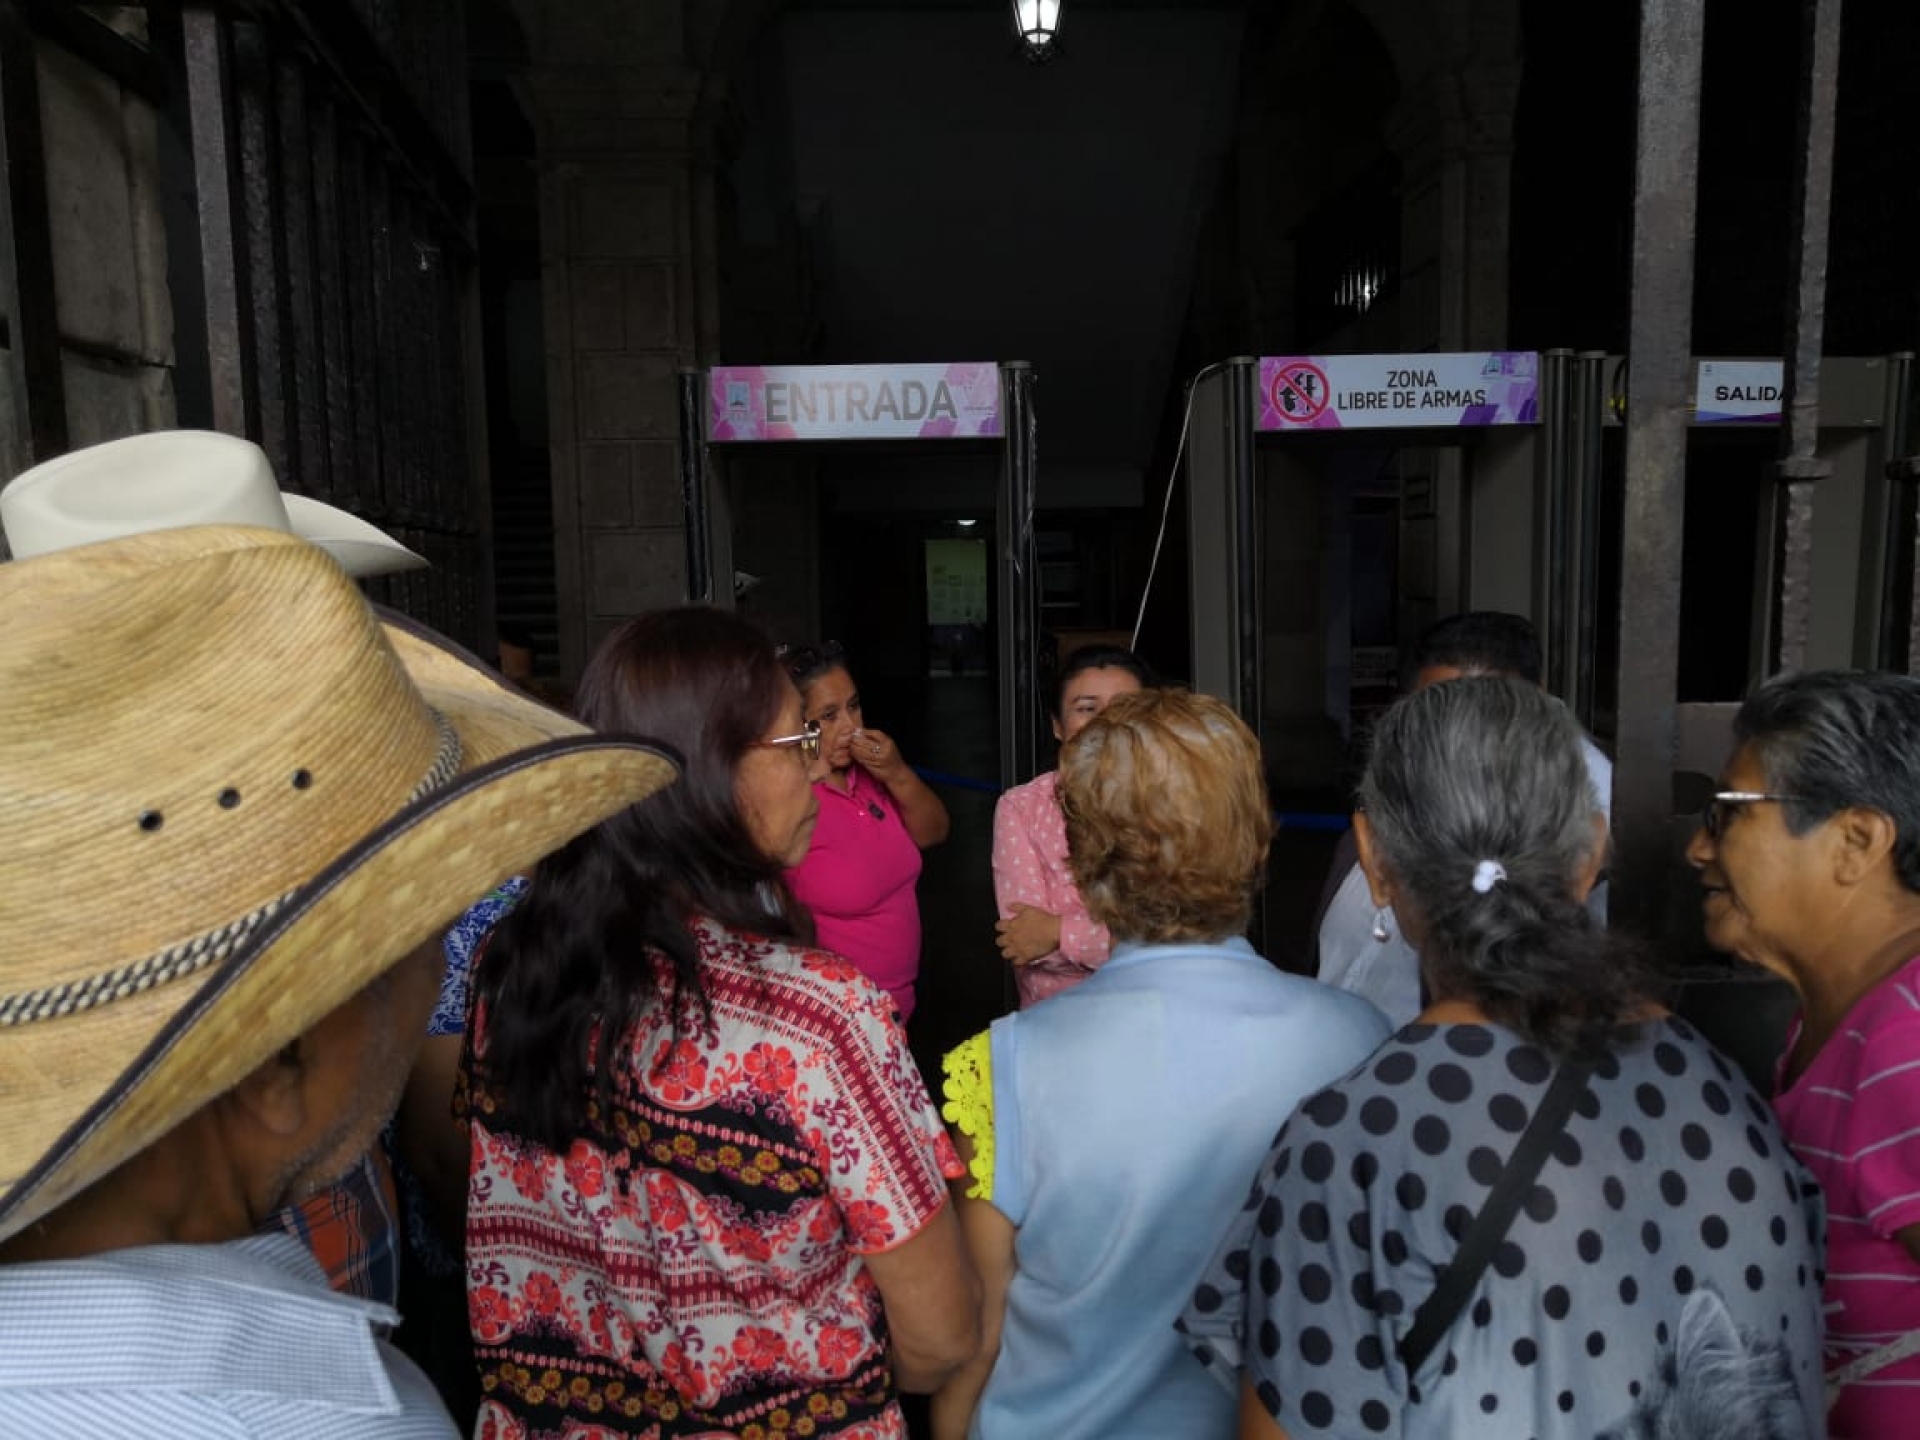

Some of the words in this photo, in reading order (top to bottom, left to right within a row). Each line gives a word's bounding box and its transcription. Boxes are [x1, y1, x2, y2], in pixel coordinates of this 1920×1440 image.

[1387, 370, 1438, 387] ZONA
[765, 380, 957, 422] ENTRADA
[1337, 392, 1387, 411] LIBRE
[1393, 391, 1416, 408] DE
[1420, 389, 1486, 408] ARMAS
